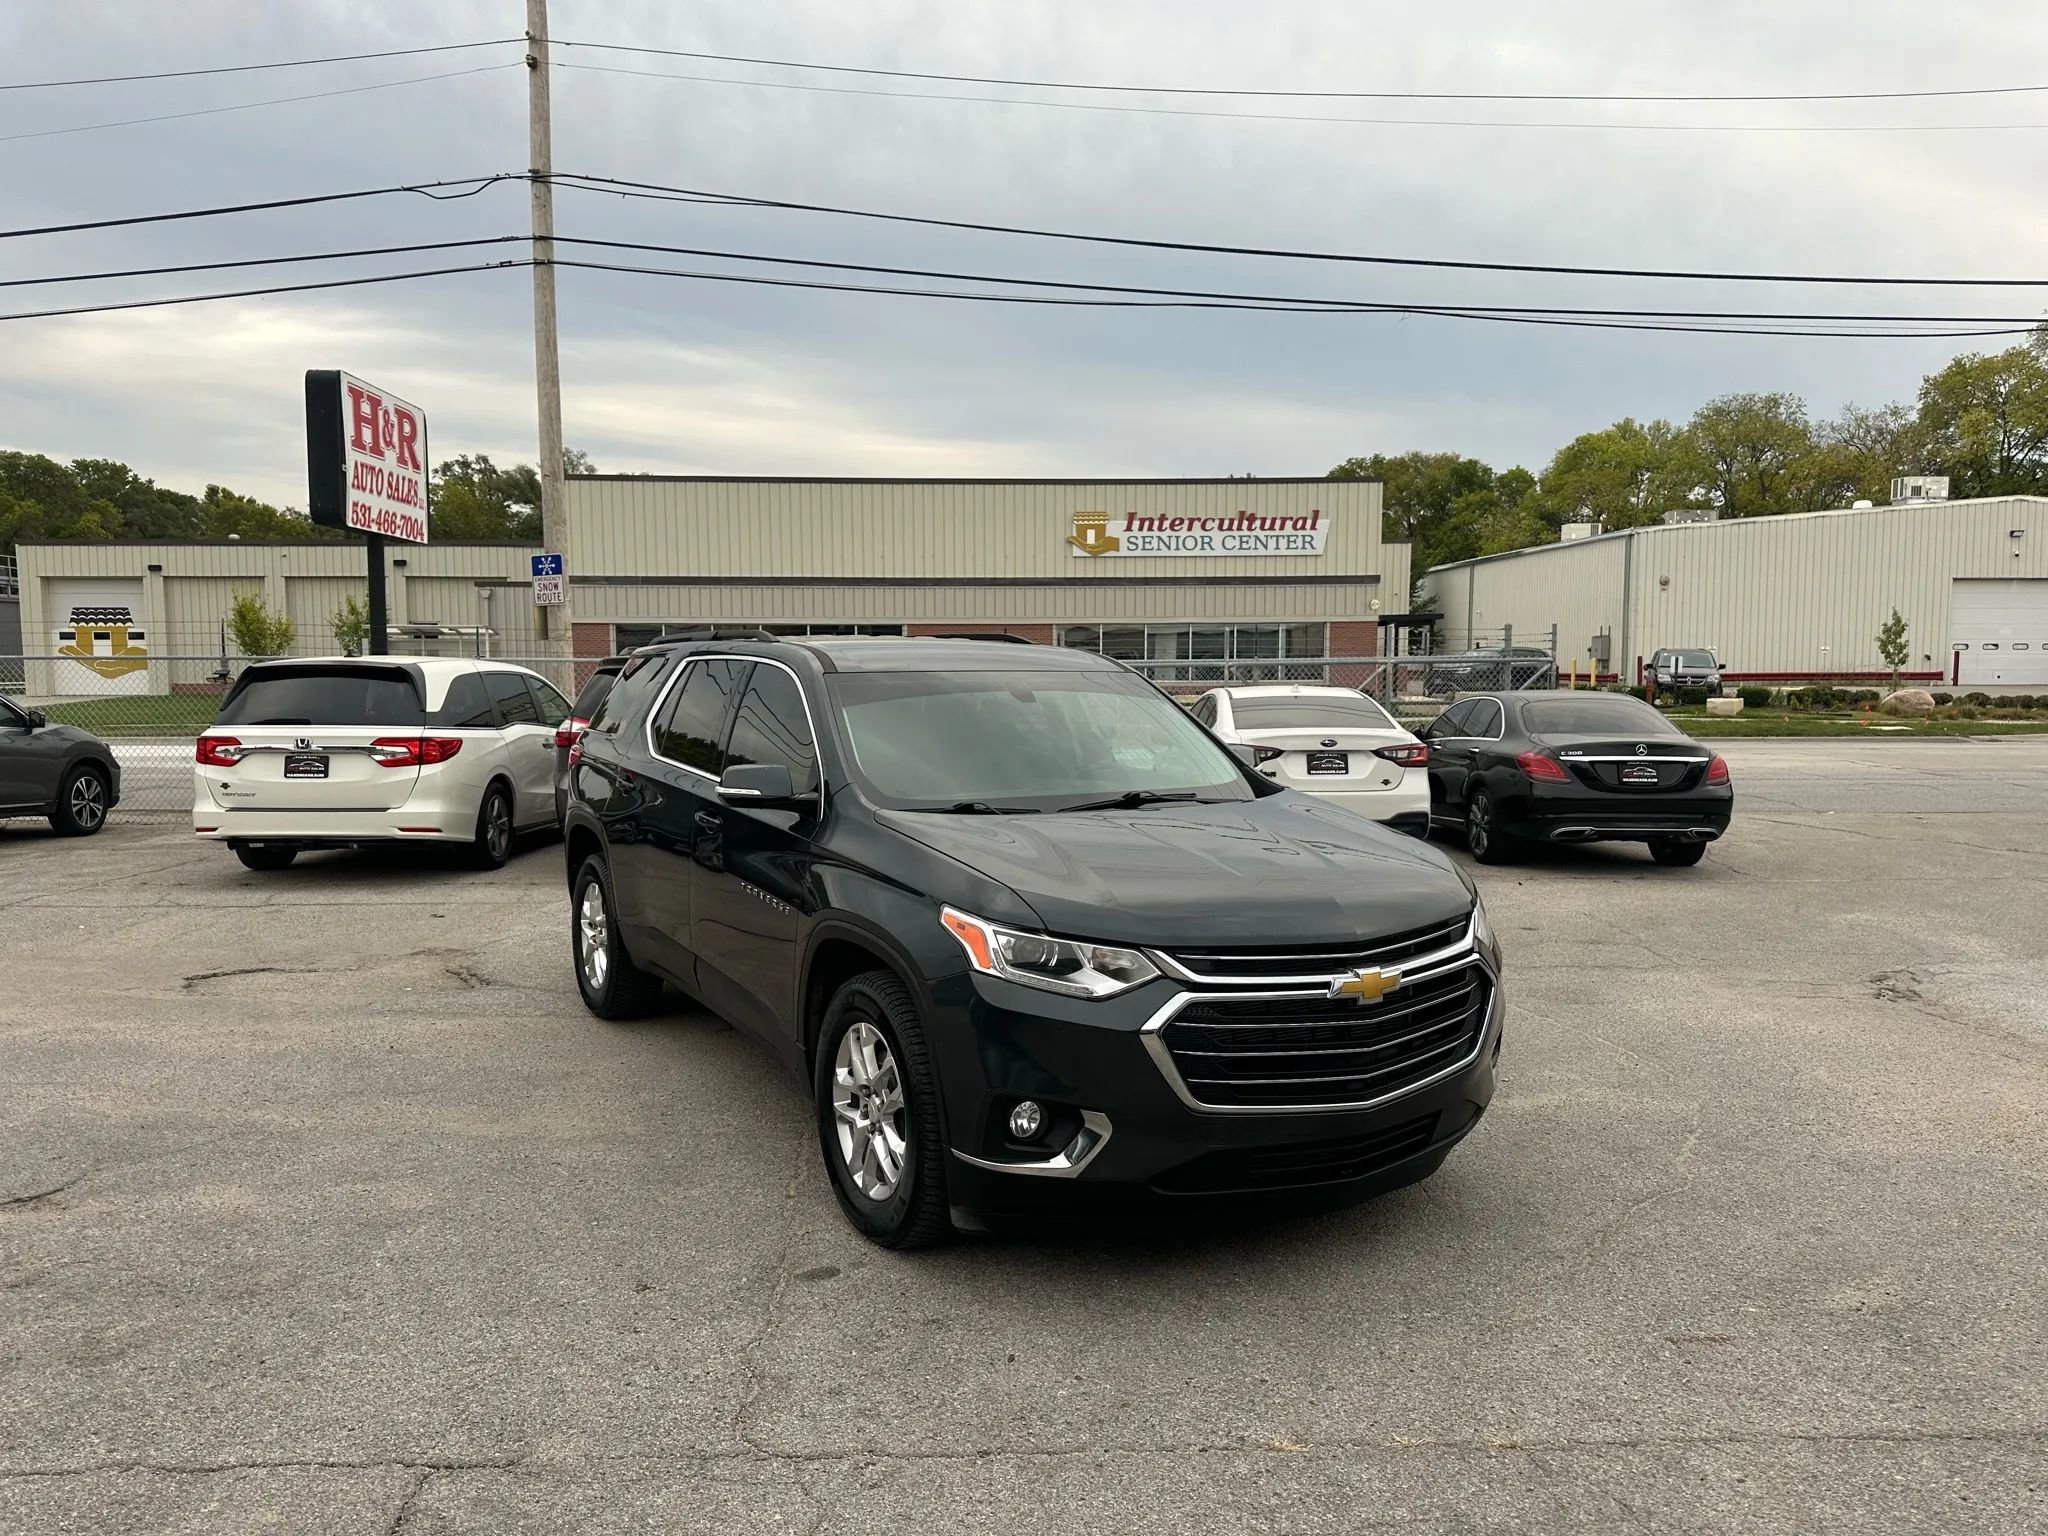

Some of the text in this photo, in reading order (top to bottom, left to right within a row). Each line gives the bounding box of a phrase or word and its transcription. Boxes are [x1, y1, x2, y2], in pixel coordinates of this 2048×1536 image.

[347, 381, 421, 474] H&R
[351, 460, 419, 508] AUTO SALES
[351, 500, 425, 542] 531-466-7004
[1123, 510, 1320, 532] Intercultural
[1126, 534, 1317, 551] SENIOR CENTER
[536, 591, 563, 603] ROUTE
[537, 582, 559, 592] SNOW
